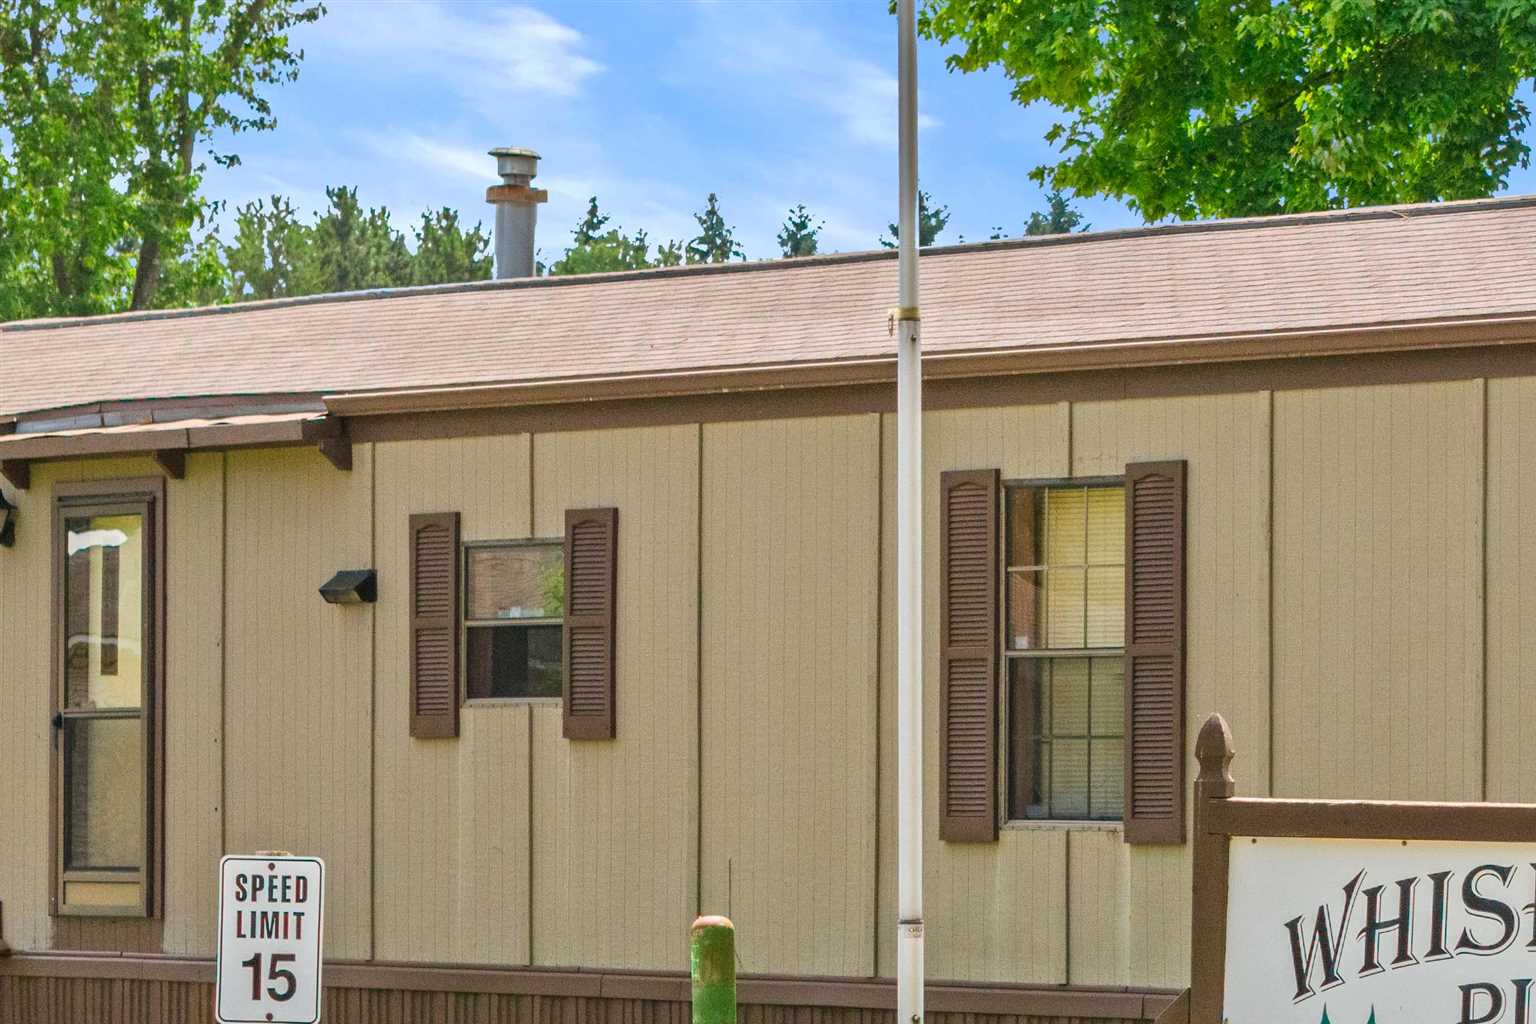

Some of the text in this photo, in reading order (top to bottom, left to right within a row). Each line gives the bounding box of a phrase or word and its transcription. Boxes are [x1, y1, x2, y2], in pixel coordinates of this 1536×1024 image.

[235, 873, 308, 904] SPEED
[236, 910, 305, 940] LIMIT
[241, 952, 297, 1002] 15
